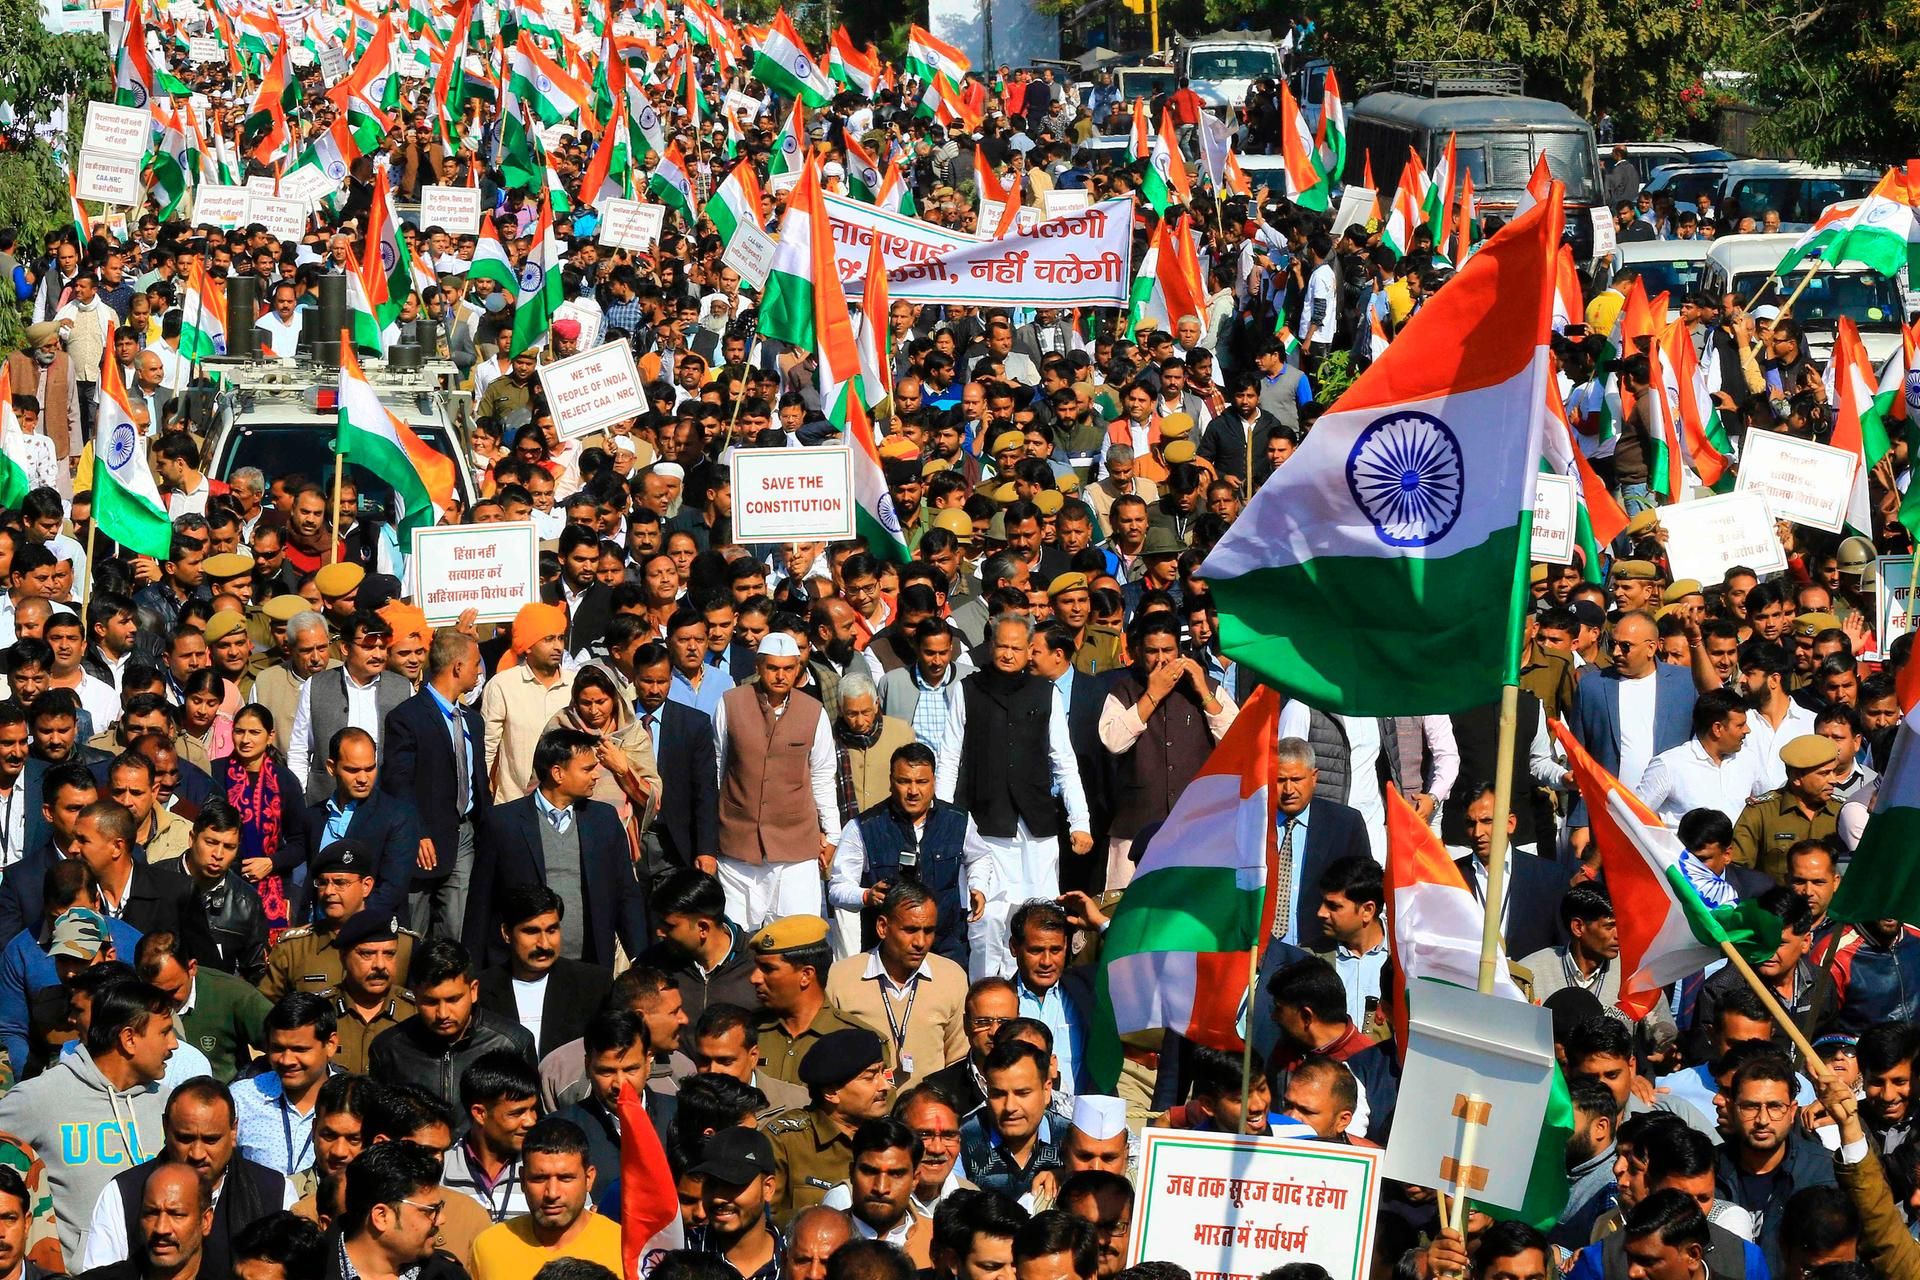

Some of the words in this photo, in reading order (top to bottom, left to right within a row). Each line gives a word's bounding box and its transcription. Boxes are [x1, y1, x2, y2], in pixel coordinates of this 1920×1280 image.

[252, 214, 274, 222] PEOPLE
[968, 250, 1030, 283] नहीं
[1034, 251, 1123, 284] चलेगी
[570, 369, 584, 381] WE
[585, 363, 603, 376] THE
[558, 385, 590, 403] PEOPLE
[591, 380, 601, 391] OF
[603, 372, 628, 387] INDIA
[561, 401, 592, 420] REJECT
[594, 395, 611, 408] CAA
[616, 387, 635, 400] NRC
[762, 476, 794, 490] SAVE
[798, 475, 824, 488] THE
[746, 498, 841, 514] CONSTITUTION
[1551, 528, 1565, 540] करो
[454, 546, 476, 560] हिंसा
[477, 544, 497, 559] नहीं
[448, 568, 485, 581] सत्याग्रह
[487, 564, 503, 578] करें
[427, 588, 479, 604] अहिंसात्मक
[481, 585, 507, 599] विरोध
[509, 582, 525, 597] करें
[1166, 1174, 1196, 1197] जब
[1198, 1177, 1226, 1197] तक
[1229, 1179, 1270, 1209] सूरज
[1272, 1177, 1303, 1206] चांद
[1306, 1180, 1348, 1210] रहेगा
[1194, 1223, 1235, 1247] भारत
[1237, 1220, 1254, 1248] में
[1254, 1223, 1309, 1253] सर्वधर्म
